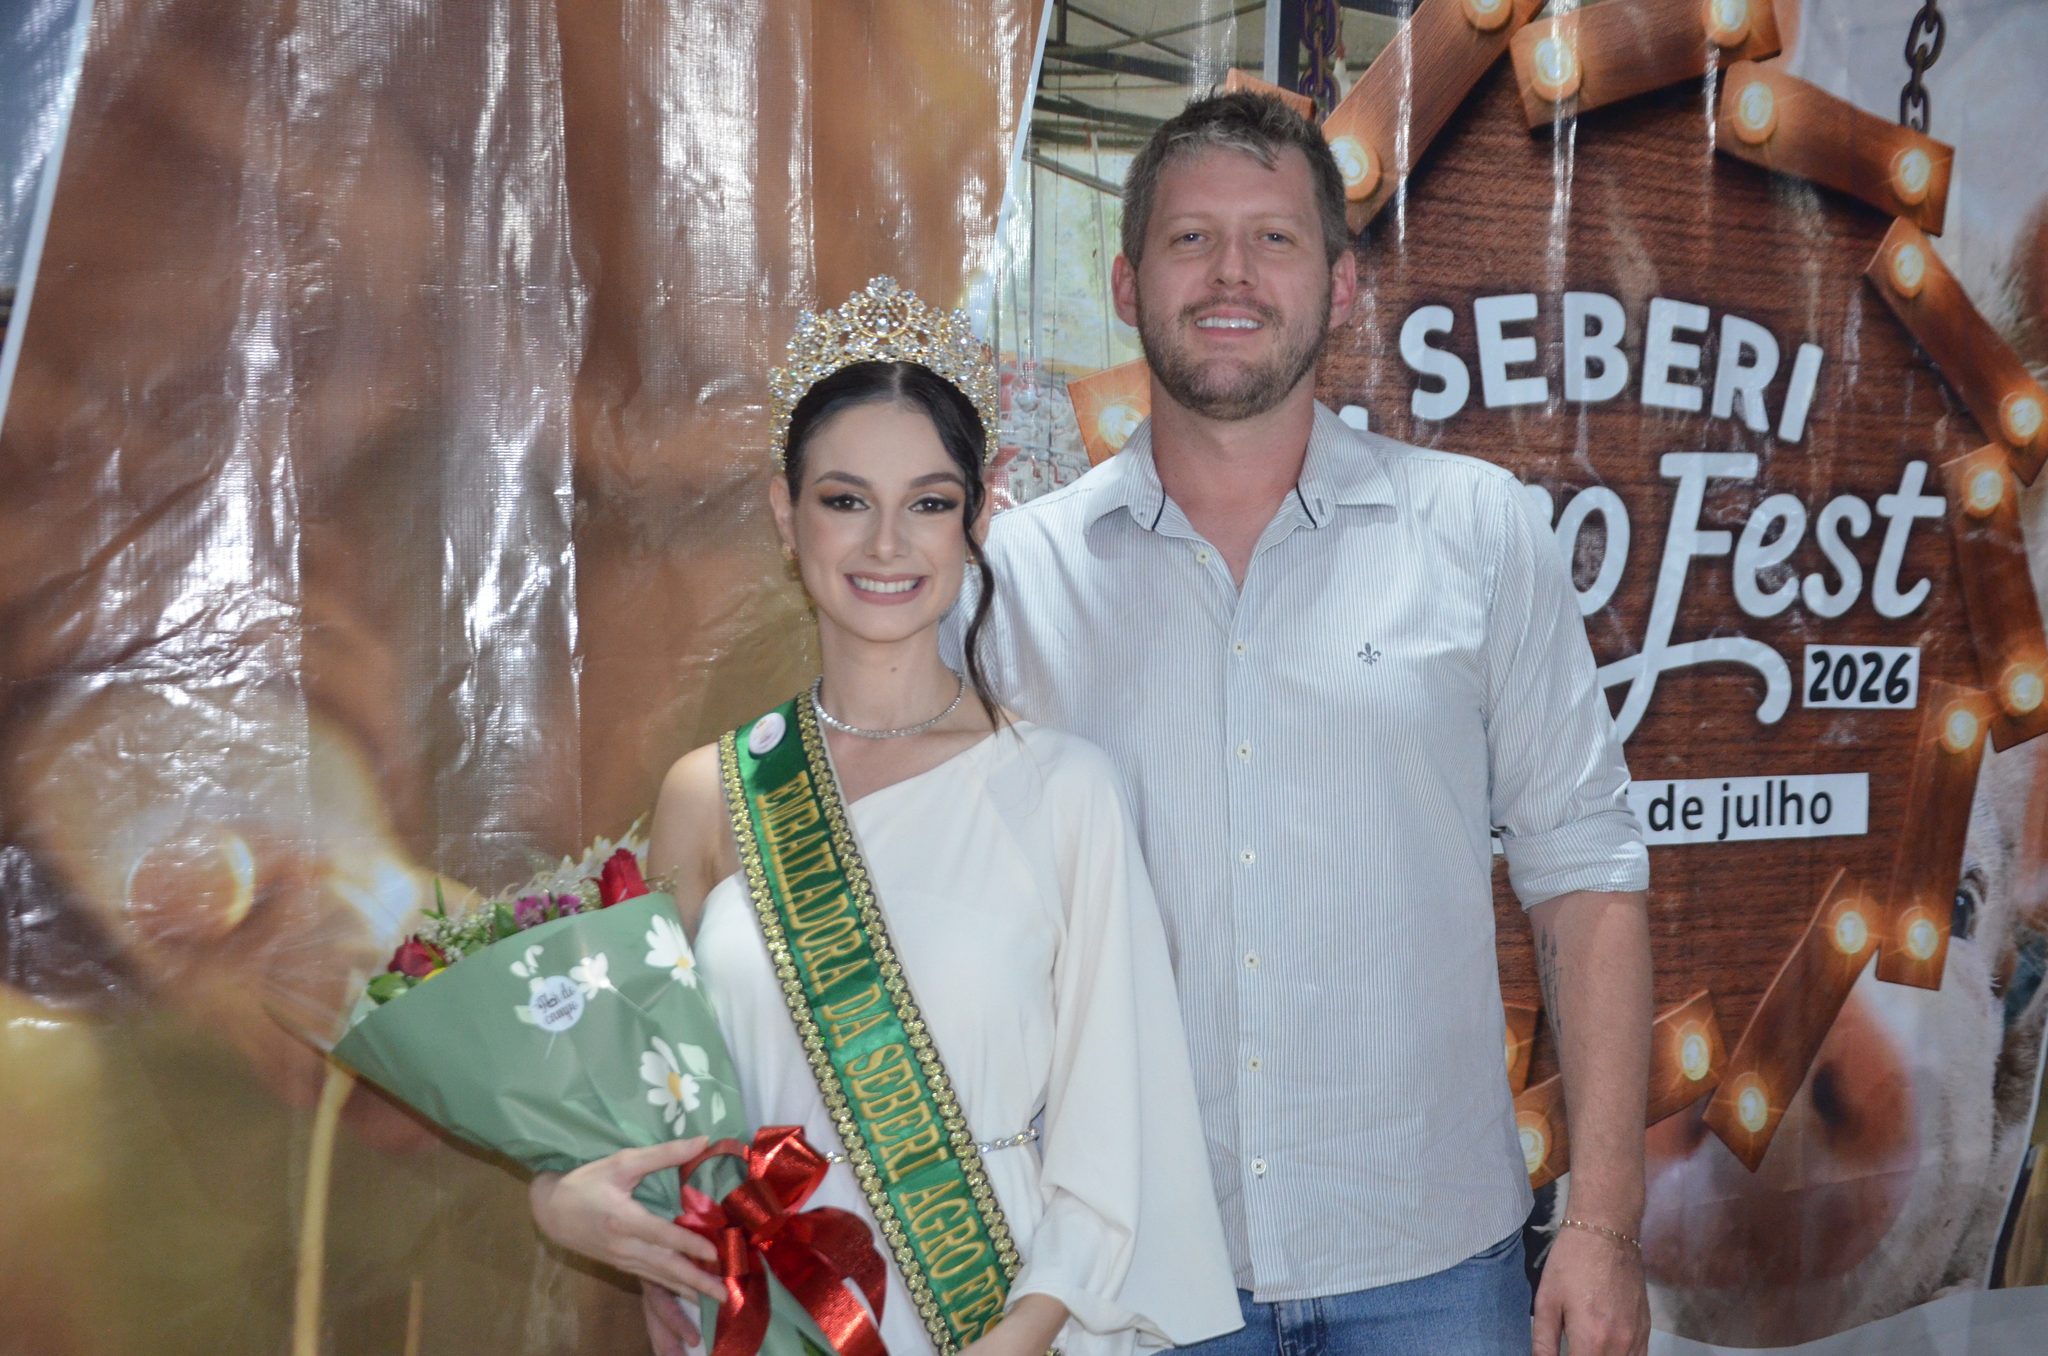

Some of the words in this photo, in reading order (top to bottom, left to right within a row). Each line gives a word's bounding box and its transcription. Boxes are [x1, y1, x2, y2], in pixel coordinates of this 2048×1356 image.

[1399, 291, 1824, 443] SEBERI
[1810, 650, 1912, 704] 2026
[1648, 783, 1704, 832] de
[1717, 779, 1832, 840] julho
[755, 770, 871, 995] EMBAIXADORA
[819, 982, 891, 1048] DA
[844, 1043, 949, 1184] SEBERI
[899, 1179, 987, 1279] AGRO
